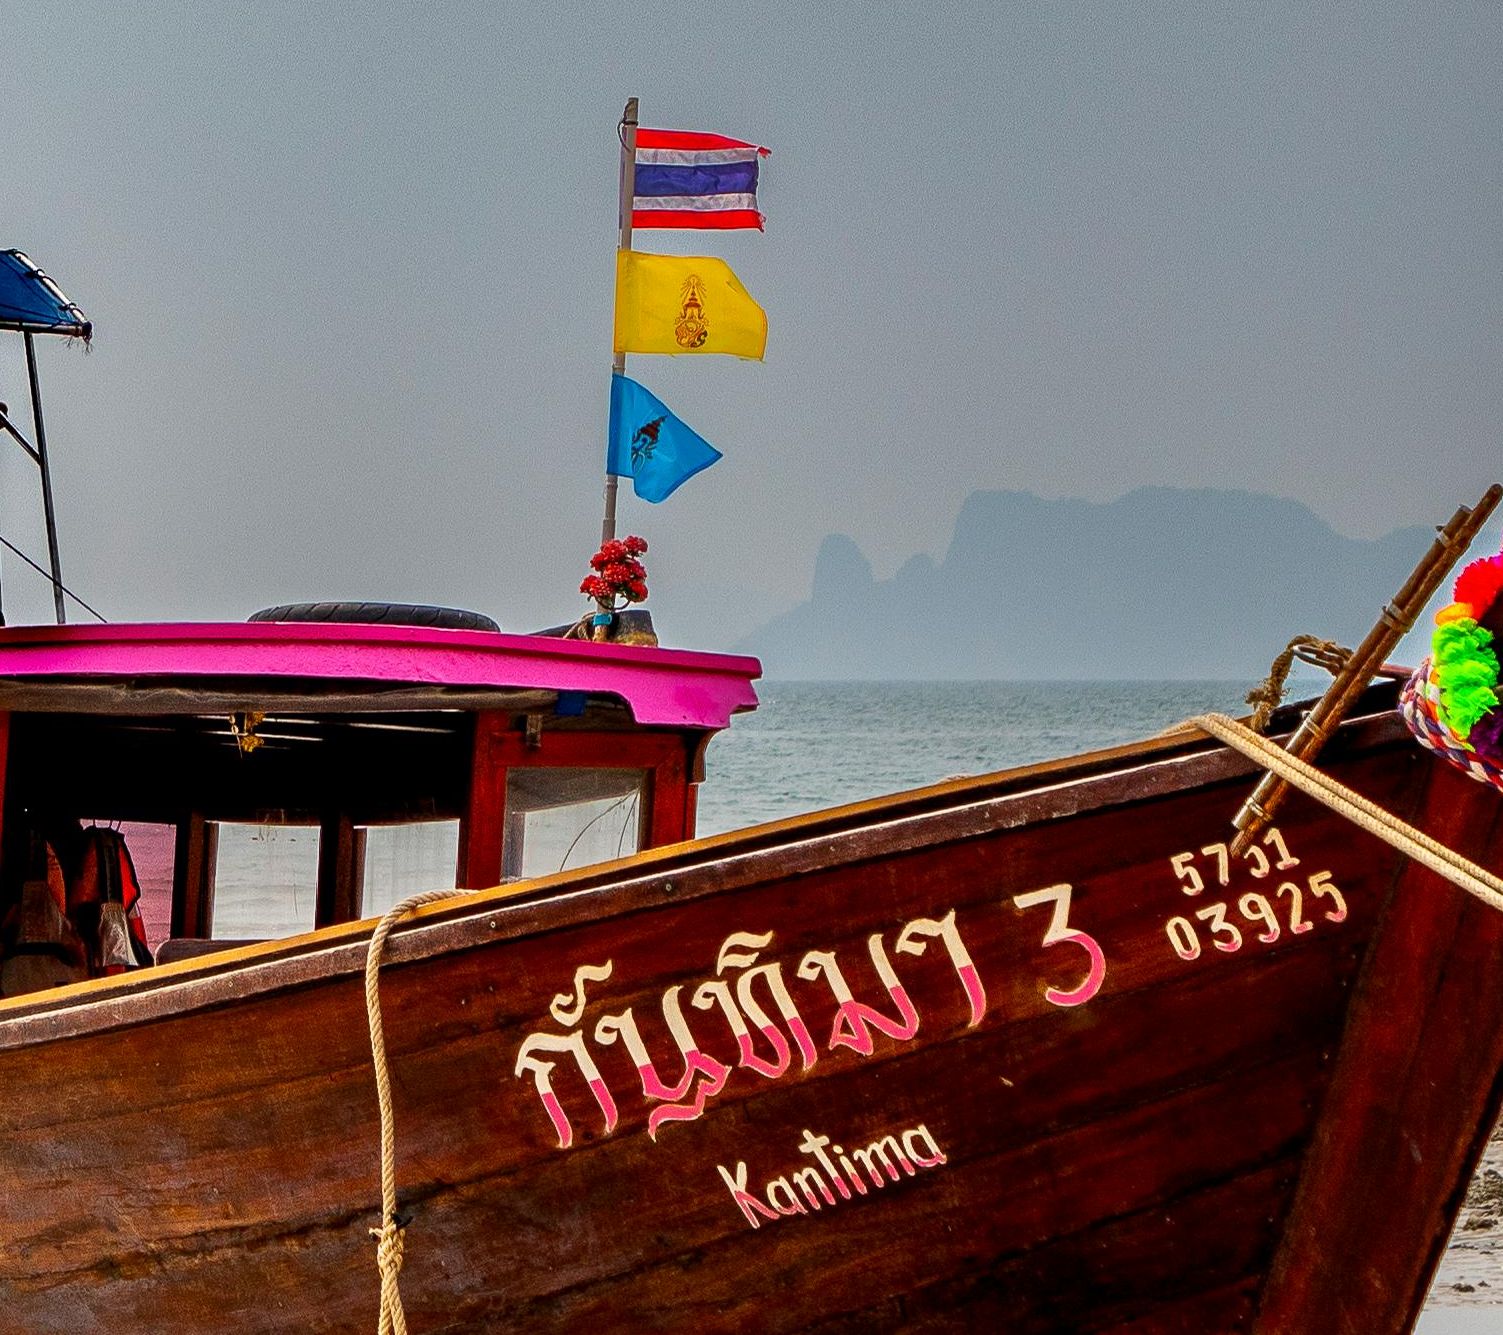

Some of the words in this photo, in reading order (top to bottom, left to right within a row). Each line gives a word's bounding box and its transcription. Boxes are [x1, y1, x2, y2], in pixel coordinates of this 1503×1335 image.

[1165, 870, 1348, 961] 03925
[513, 908, 988, 1150] กันทิมา
[1012, 882, 1108, 1009] 3
[716, 1123, 948, 1230] Kantima
